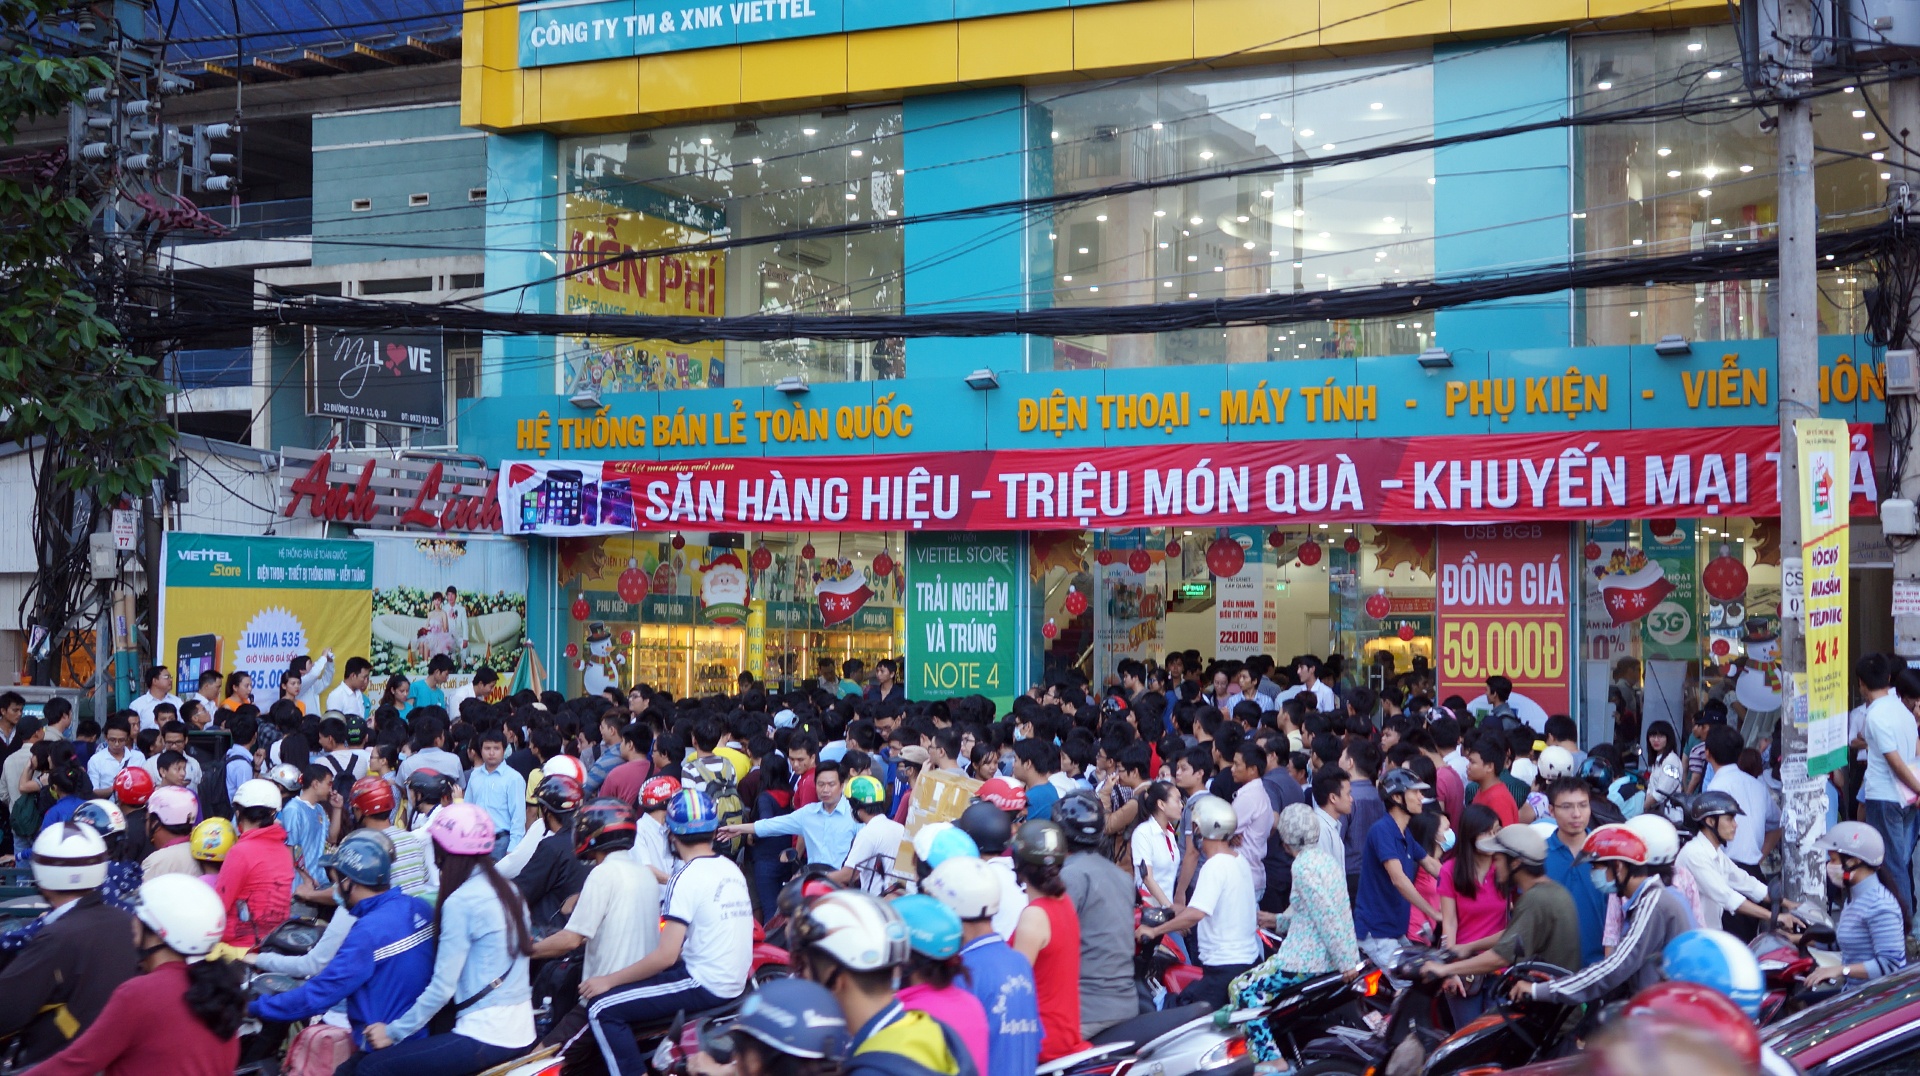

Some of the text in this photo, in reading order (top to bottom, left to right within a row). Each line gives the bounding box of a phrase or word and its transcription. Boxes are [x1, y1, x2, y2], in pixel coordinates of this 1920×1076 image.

[530, 0, 816, 48] CÔNG TY TM & XNK VIETTEL
[659, 254, 719, 315] PHÍ
[329, 329, 381, 399] My
[1018, 388, 1088, 437] ĐIỆN
[1096, 391, 1190, 433] THOẠI
[1220, 380, 1291, 425] MÁY
[1300, 377, 1377, 422] TÍNH
[1445, 376, 1515, 423] PHỤ
[1525, 366, 1608, 419] KIỆN
[1681, 352, 1767, 408] VIỄN
[1818, 354, 1886, 404] HÔN
[516, 392, 914, 456] HỆ THỐNG BÁN LẺ TOÀN QUỐC
[645, 470, 725, 522] SĂN
[737, 470, 848, 521] HÀNG
[862, 466, 960, 528] HIỆU
[999, 462, 1128, 526] TRIỆU
[1143, 458, 1249, 516] MÓN
[1265, 453, 1364, 515] QUÀ
[1414, 442, 1626, 510] KHUYẾN
[1645, 453, 1747, 514] MẠI
[119, 537, 129, 546] T7
[1464, 525, 1542, 539] USB 8GB
[209, 563, 241, 577] Store
[916, 546, 1009, 563] VIETTEL STORE
[1442, 550, 1564, 606] ĐỒNG GIÁ
[653, 603, 684, 617] PHỤ KIỆN
[915, 573, 1008, 618] TRẢI NGHIỆM
[863, 611, 874, 626] PHỤ
[1650, 612, 1684, 633] 3G
[246, 631, 300, 648] LUMIA 535
[926, 617, 946, 653] VÀ
[949, 618, 997, 653] TRÚNG
[1443, 621, 1564, 679] 59.000Đ
[246, 653, 257, 663] GIỜ
[258, 653, 274, 663] VÀNG
[924, 662, 999, 689] NOTE 4
